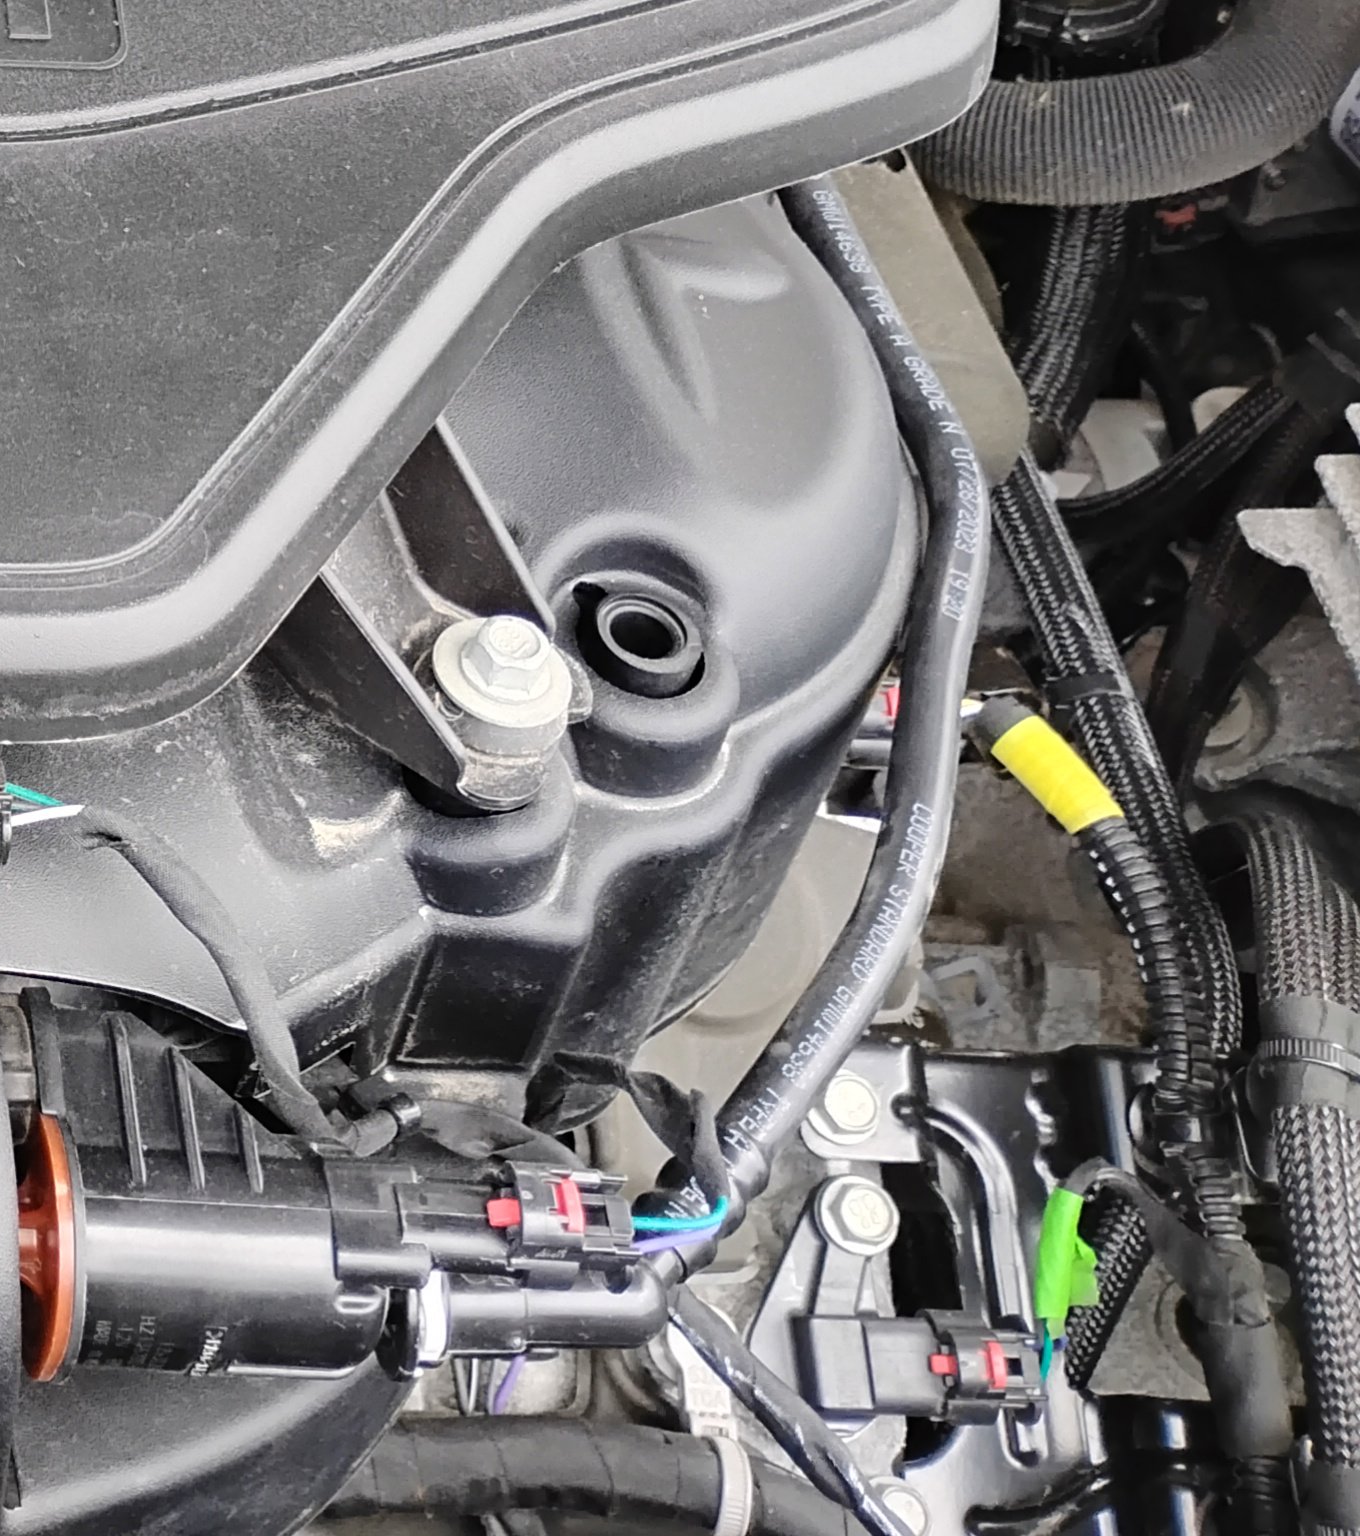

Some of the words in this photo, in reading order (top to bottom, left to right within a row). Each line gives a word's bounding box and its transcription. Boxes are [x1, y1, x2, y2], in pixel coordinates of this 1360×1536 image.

[861, 284, 903, 327] TYPE
[903, 356, 955, 414] GRADE
[938, 419, 968, 436] N
[896, 802, 935, 880] COOPER
[851, 884, 912, 984] STANDARD
